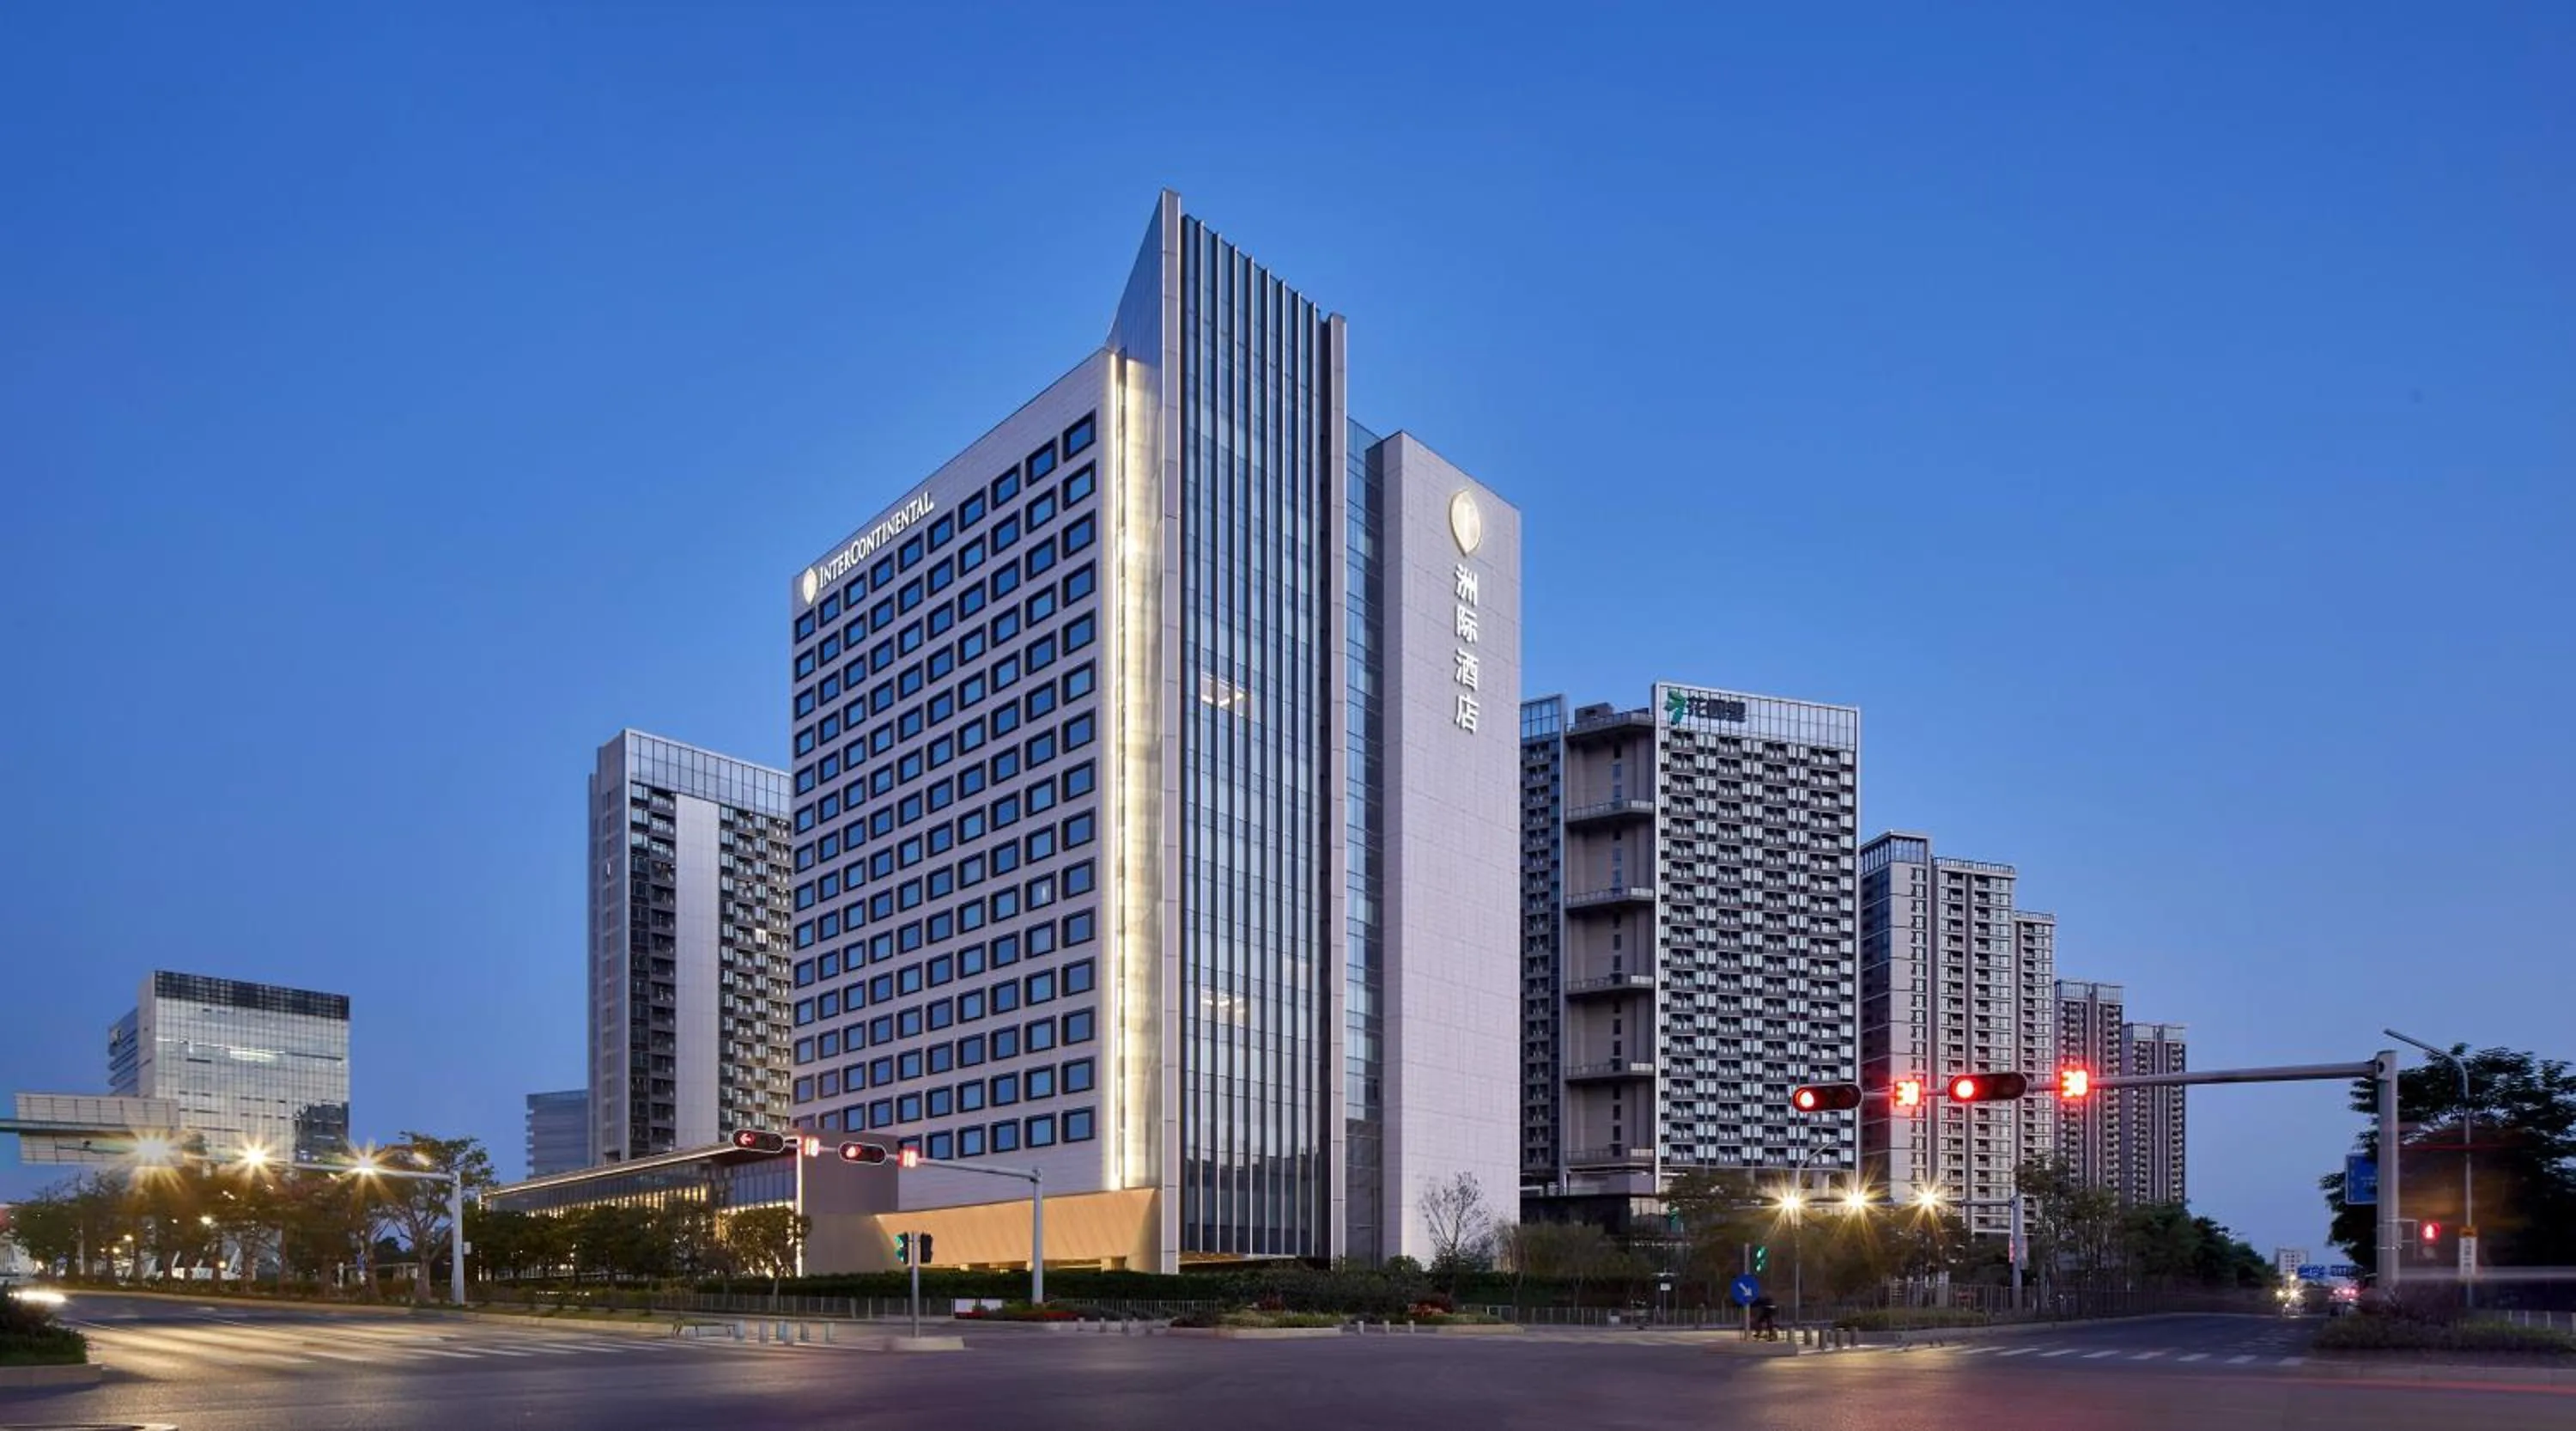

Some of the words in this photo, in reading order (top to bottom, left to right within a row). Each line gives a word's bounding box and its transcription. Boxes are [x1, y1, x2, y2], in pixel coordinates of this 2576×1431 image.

[819, 490, 935, 588] INTERCONTINENTAL
[1455, 563, 1479, 733] 洲际酒店
